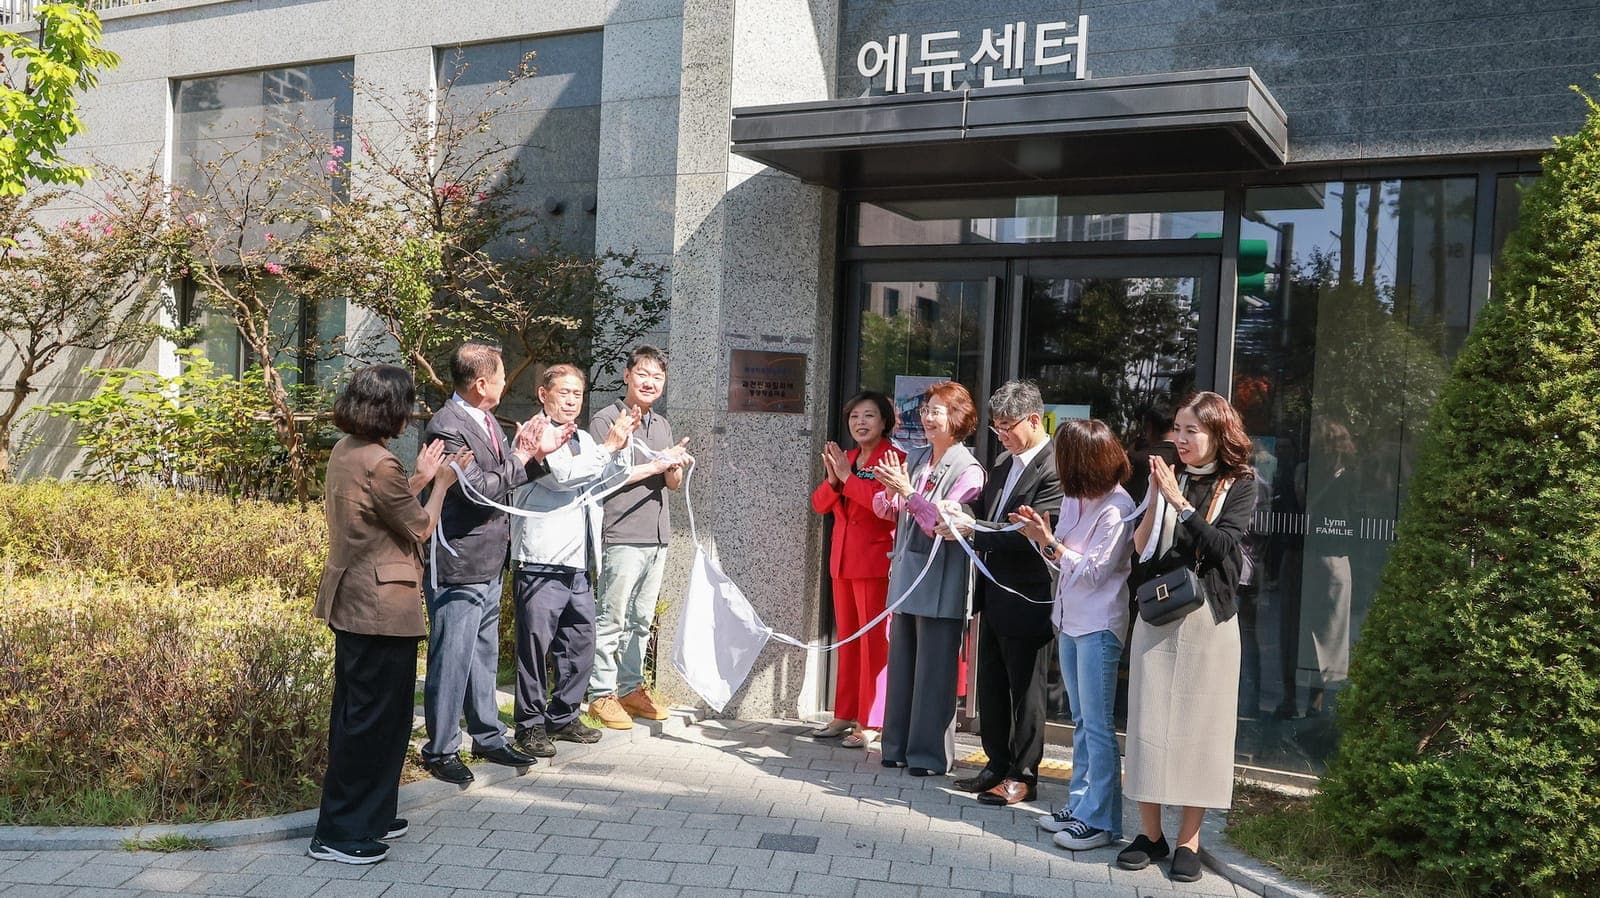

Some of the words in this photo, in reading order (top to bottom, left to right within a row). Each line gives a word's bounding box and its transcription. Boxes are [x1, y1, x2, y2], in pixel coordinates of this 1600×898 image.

[857, 14, 1089, 94] 에듀센터
[1324, 517, 1346, 528] Lynn
[1315, 526, 1354, 537] FAMILIE
